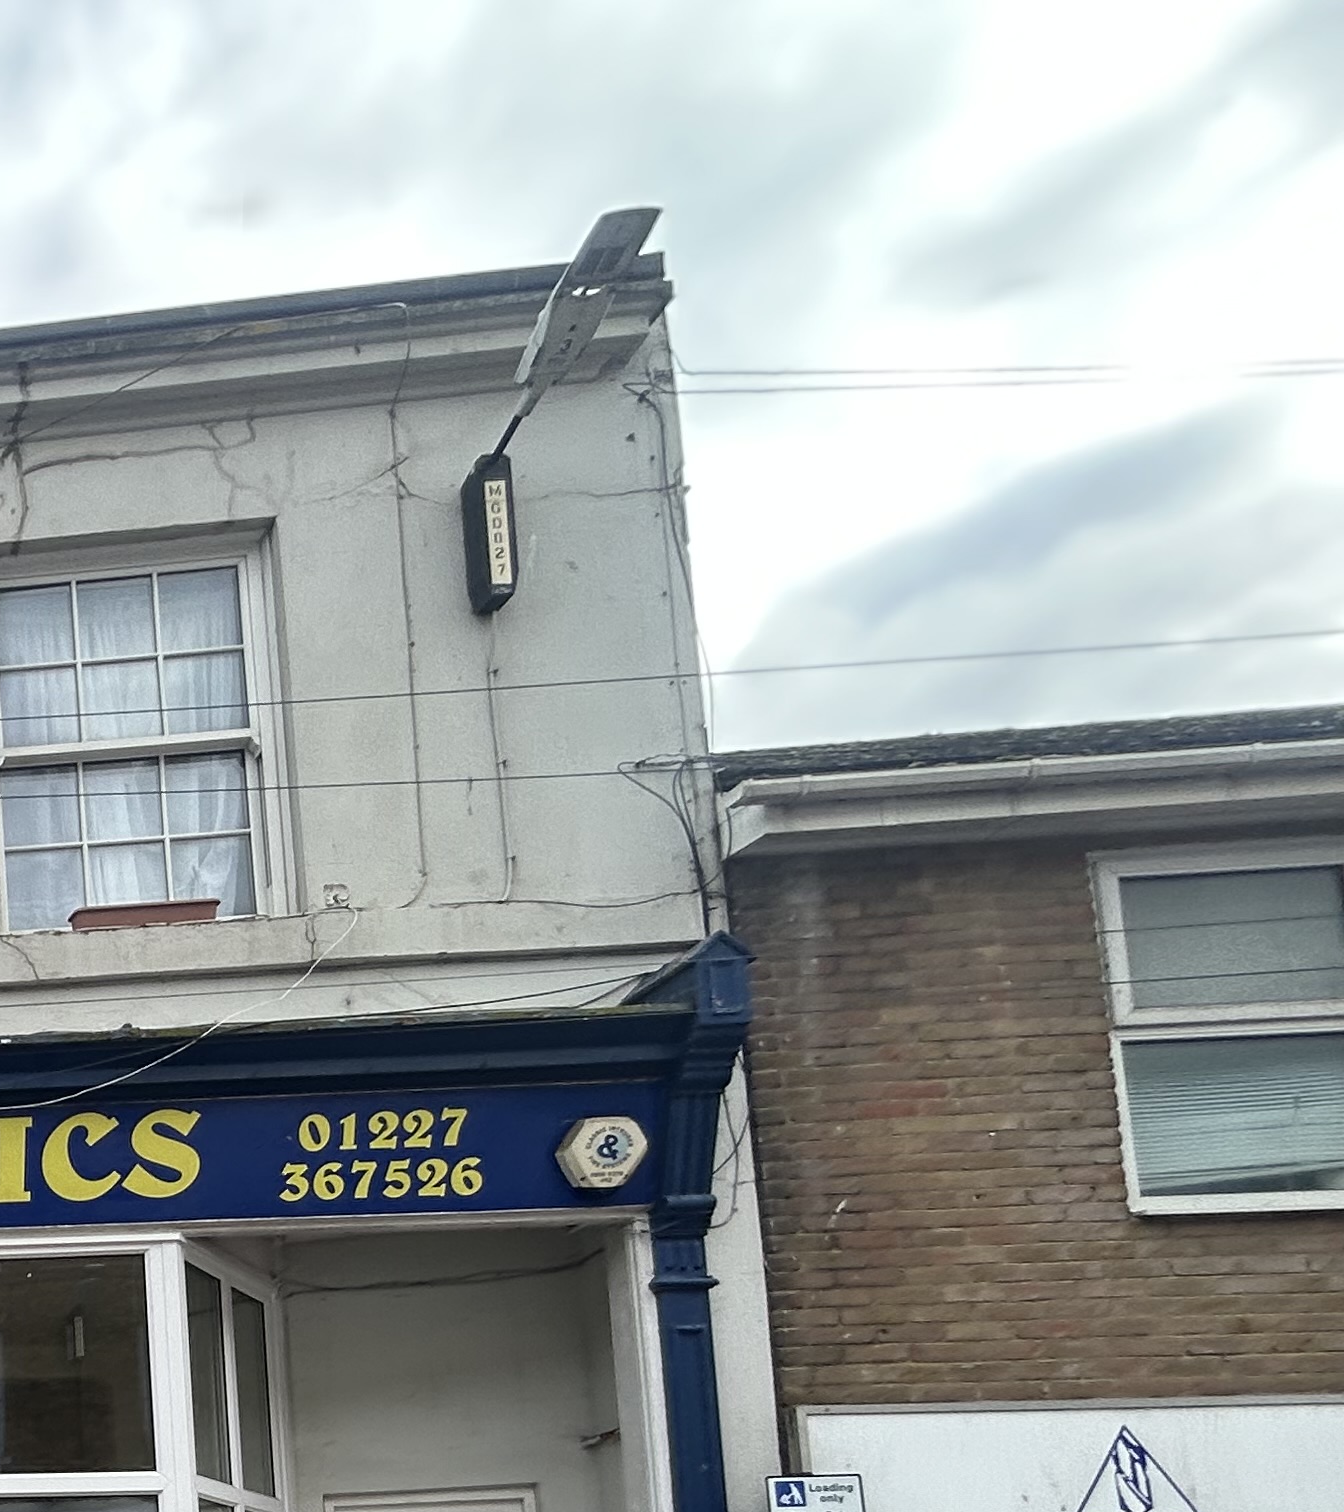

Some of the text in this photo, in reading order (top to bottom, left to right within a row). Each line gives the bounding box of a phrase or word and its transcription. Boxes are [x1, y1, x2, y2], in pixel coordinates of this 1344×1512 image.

[298, 1106, 469, 1153] 01227
[596, 1134, 619, 1160] &
[279, 1155, 484, 1202] 367526
[808, 1483, 854, 1493] Loading
[819, 1494, 845, 1504] only
